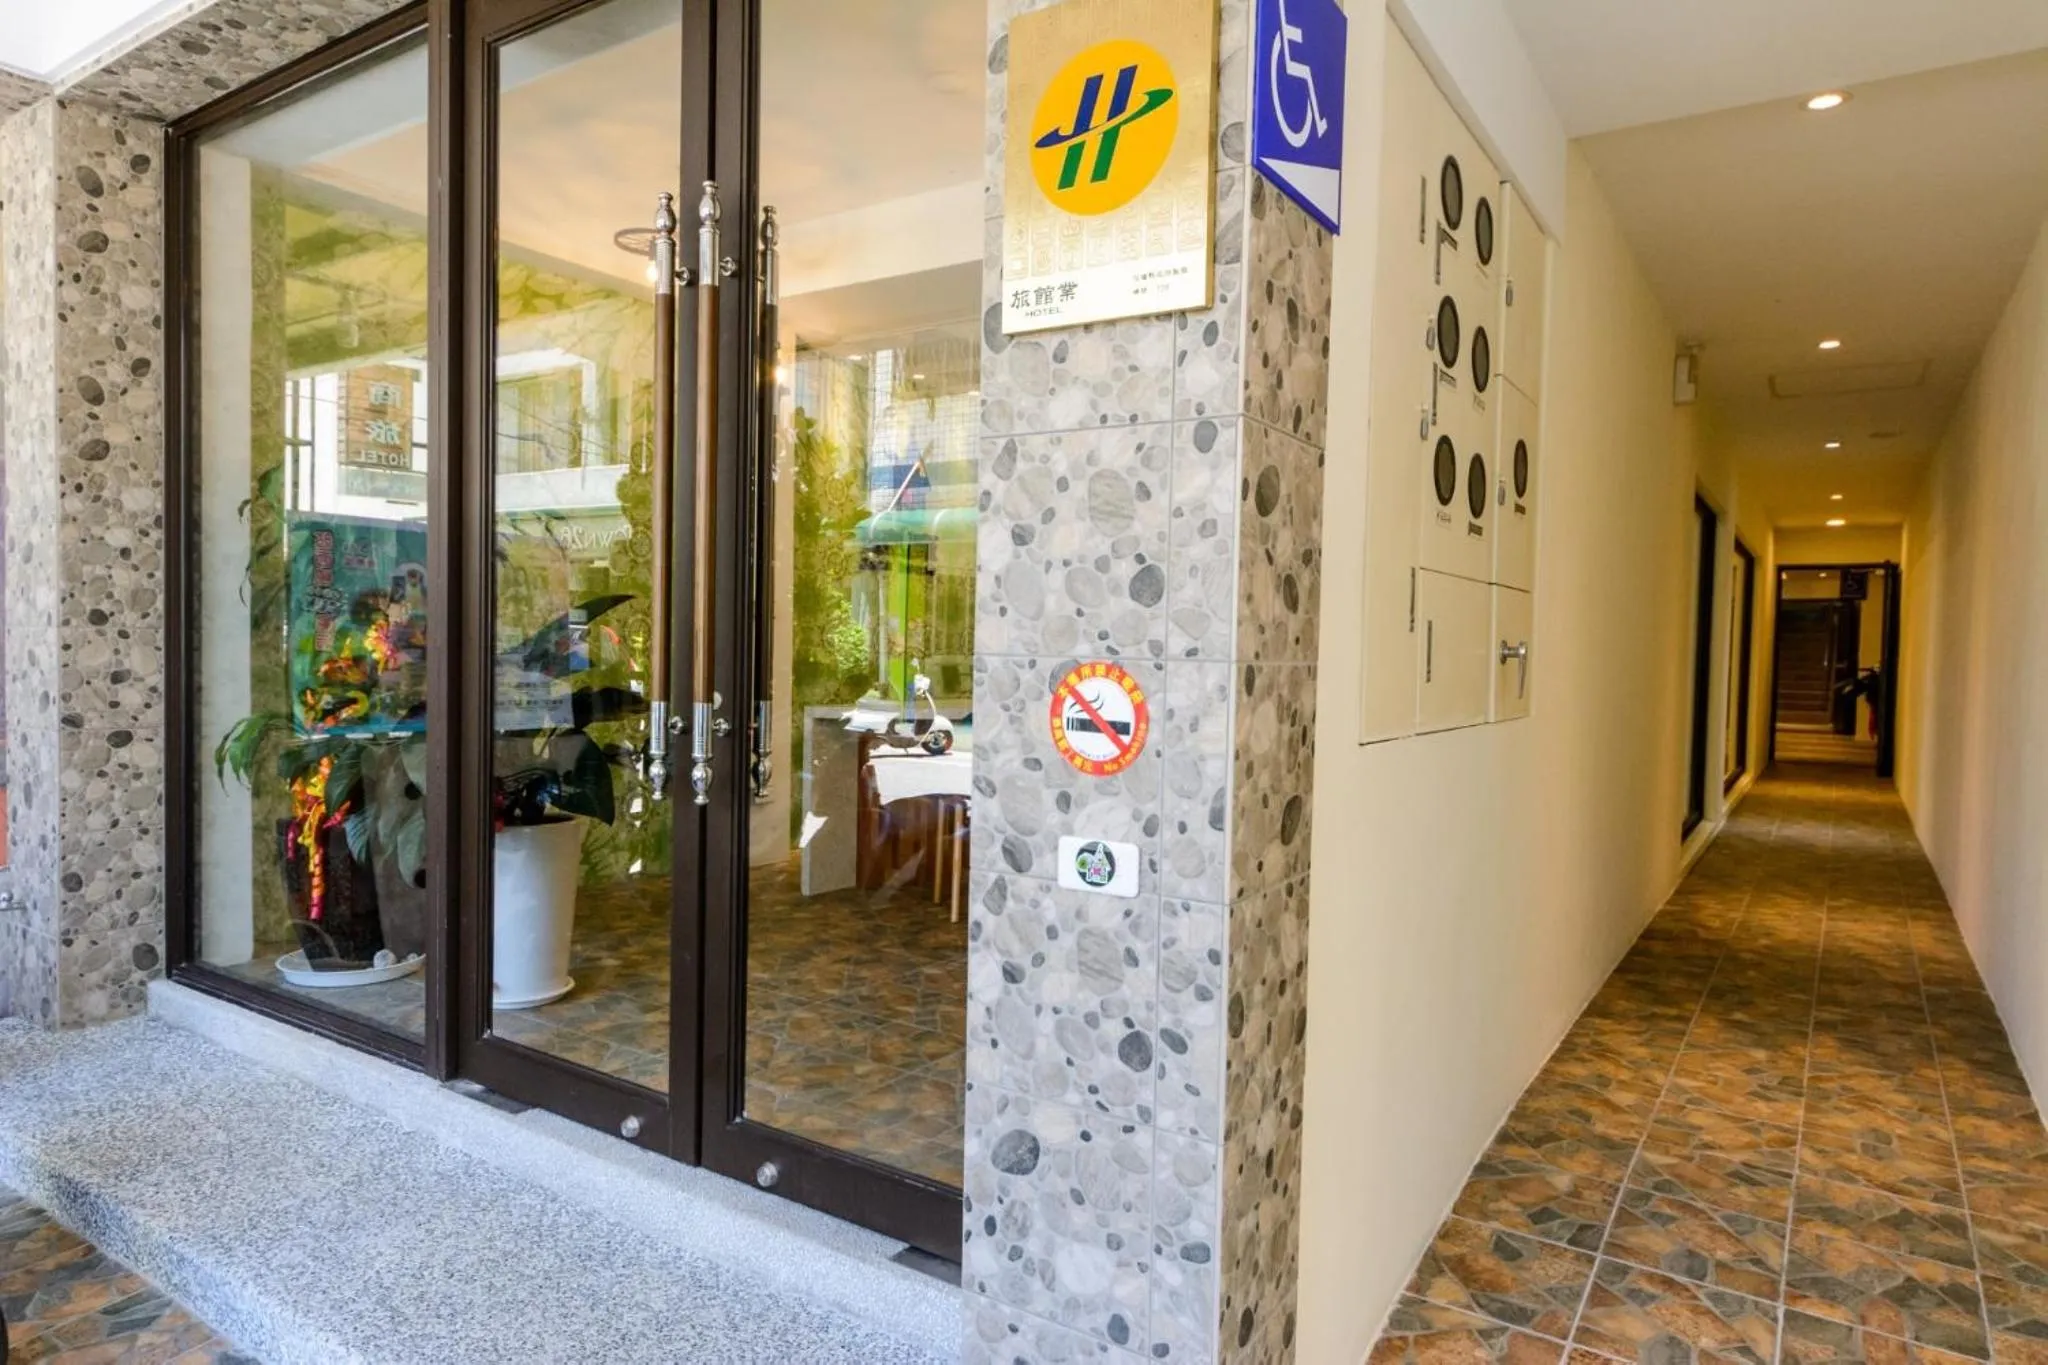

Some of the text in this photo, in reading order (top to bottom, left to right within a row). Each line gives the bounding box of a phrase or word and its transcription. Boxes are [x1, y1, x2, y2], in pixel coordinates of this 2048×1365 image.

[1010, 281, 1078, 310] 旅館業
[1026, 306, 1063, 317] HOTEL
